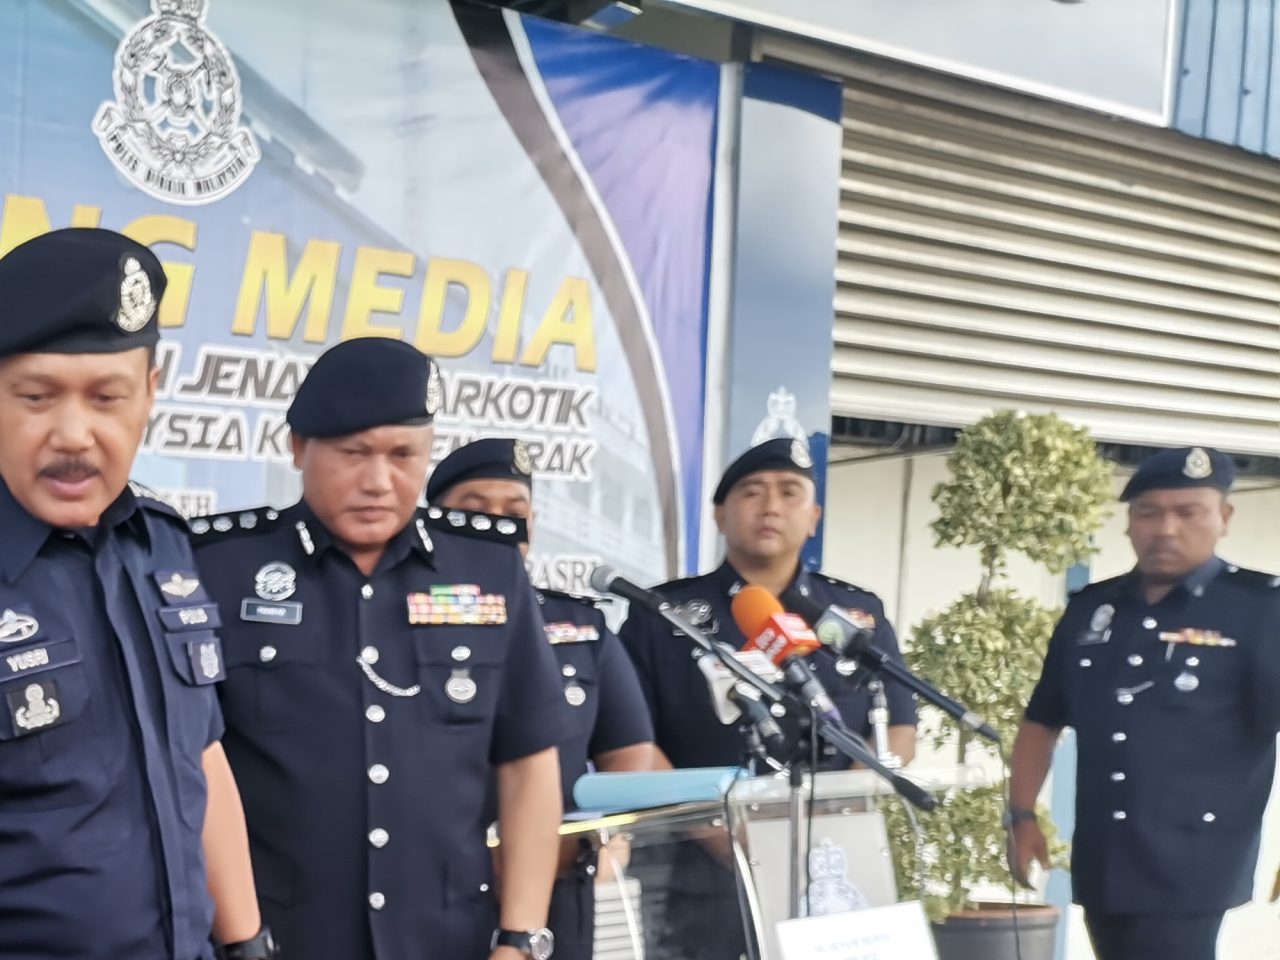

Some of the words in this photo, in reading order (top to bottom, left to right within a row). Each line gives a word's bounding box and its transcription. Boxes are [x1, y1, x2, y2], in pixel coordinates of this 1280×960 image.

[232, 231, 598, 373] MEDIA
[180, 352, 312, 402] JENA
[143, 412, 244, 454] YSIA
